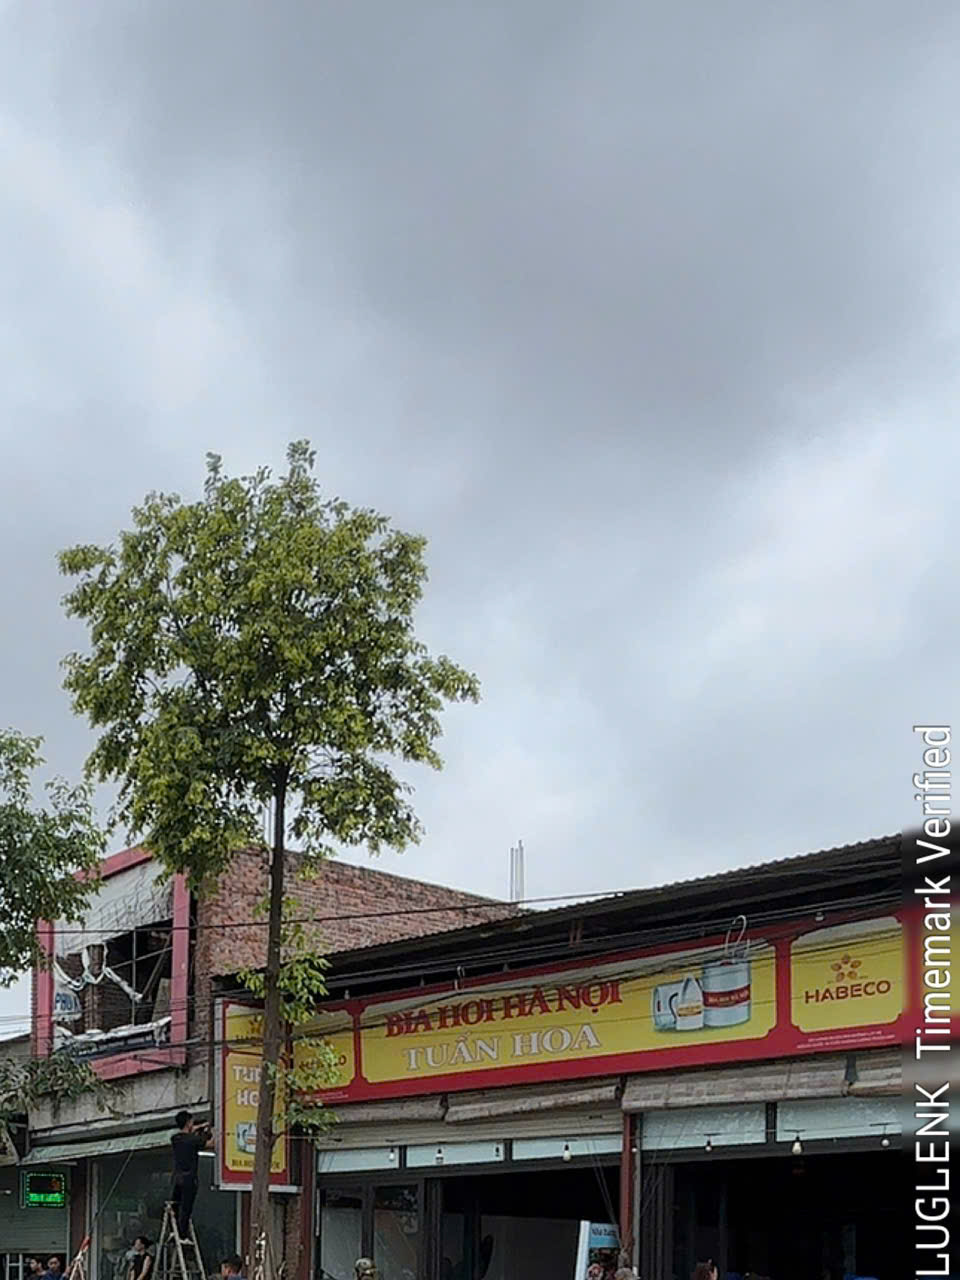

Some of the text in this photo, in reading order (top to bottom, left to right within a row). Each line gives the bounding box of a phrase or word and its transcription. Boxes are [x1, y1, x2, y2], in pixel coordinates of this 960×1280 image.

[384, 1009, 434, 1037] BIA
[501, 984, 552, 1019] HÀ
[555, 974, 623, 1013] NỘI
[804, 980, 892, 1004] HABECO
[403, 1022, 603, 1072] TUẤN HOA
